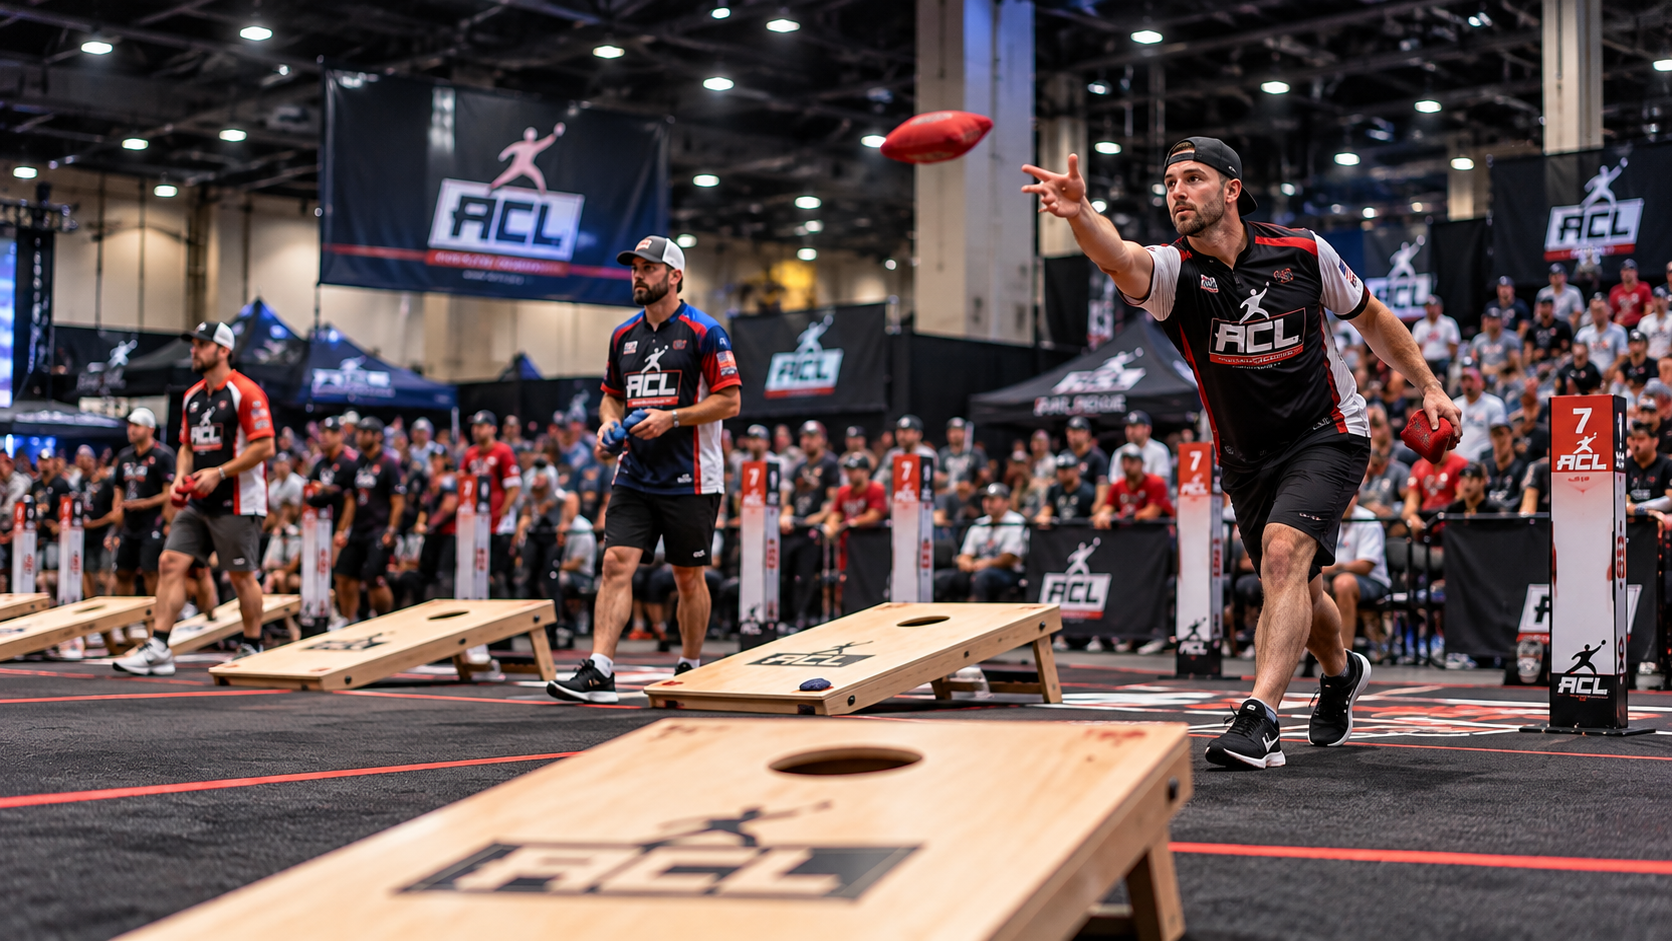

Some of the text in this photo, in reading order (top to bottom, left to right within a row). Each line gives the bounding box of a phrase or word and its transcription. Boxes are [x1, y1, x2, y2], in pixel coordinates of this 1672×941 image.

[451, 195, 563, 247] ACL
[1559, 211, 1629, 240] ACL
[1215, 318, 1300, 354] ACL
[777, 360, 828, 380] ACL
[626, 373, 676, 398] ACL
[1573, 407, 1593, 434] 7
[901, 460, 913, 481] 7
[1189, 450, 1203, 472] 7
[1556, 454, 1607, 471] ACL
[748, 468, 760, 487] 7
[1047, 582, 1099, 603] ACL
[761, 653, 847, 667] ACL
[1557, 676, 1608, 694] ACL
[453, 845, 843, 893] ACL
